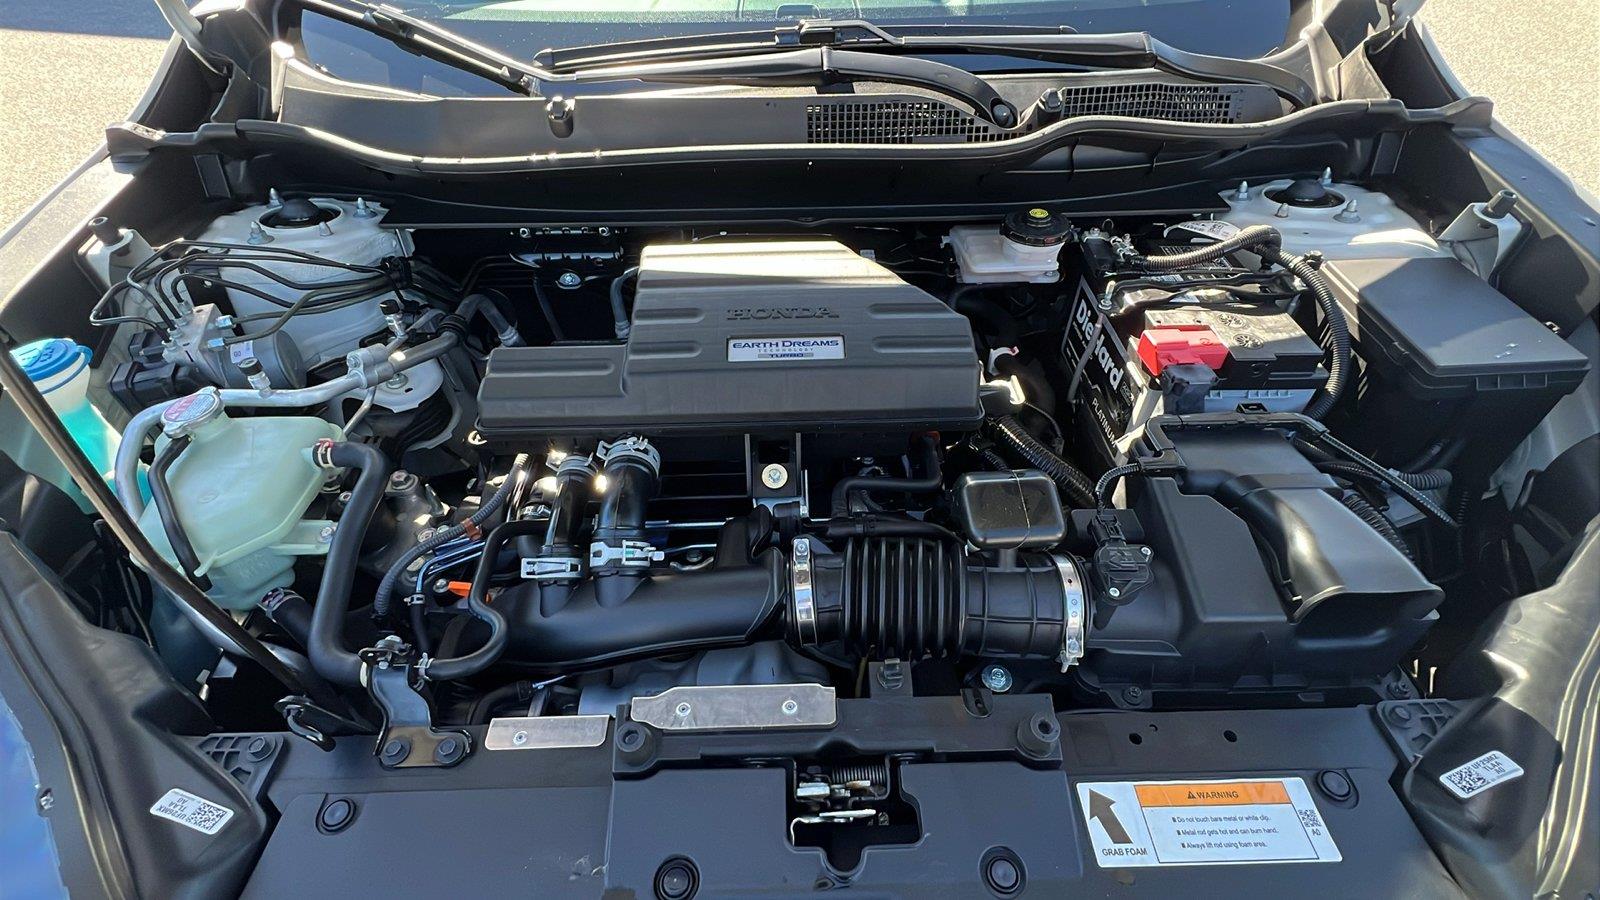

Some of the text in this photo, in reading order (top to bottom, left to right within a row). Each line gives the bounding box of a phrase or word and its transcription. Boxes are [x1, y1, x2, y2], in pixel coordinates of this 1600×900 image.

[727, 307, 840, 320] HONDA
[1092, 397, 1117, 448] PLATINUM
[1196, 790, 1239, 799] WARNING
[1260, 814, 1272, 822] clip.
[1101, 848, 1148, 856] GRAB FOAM
